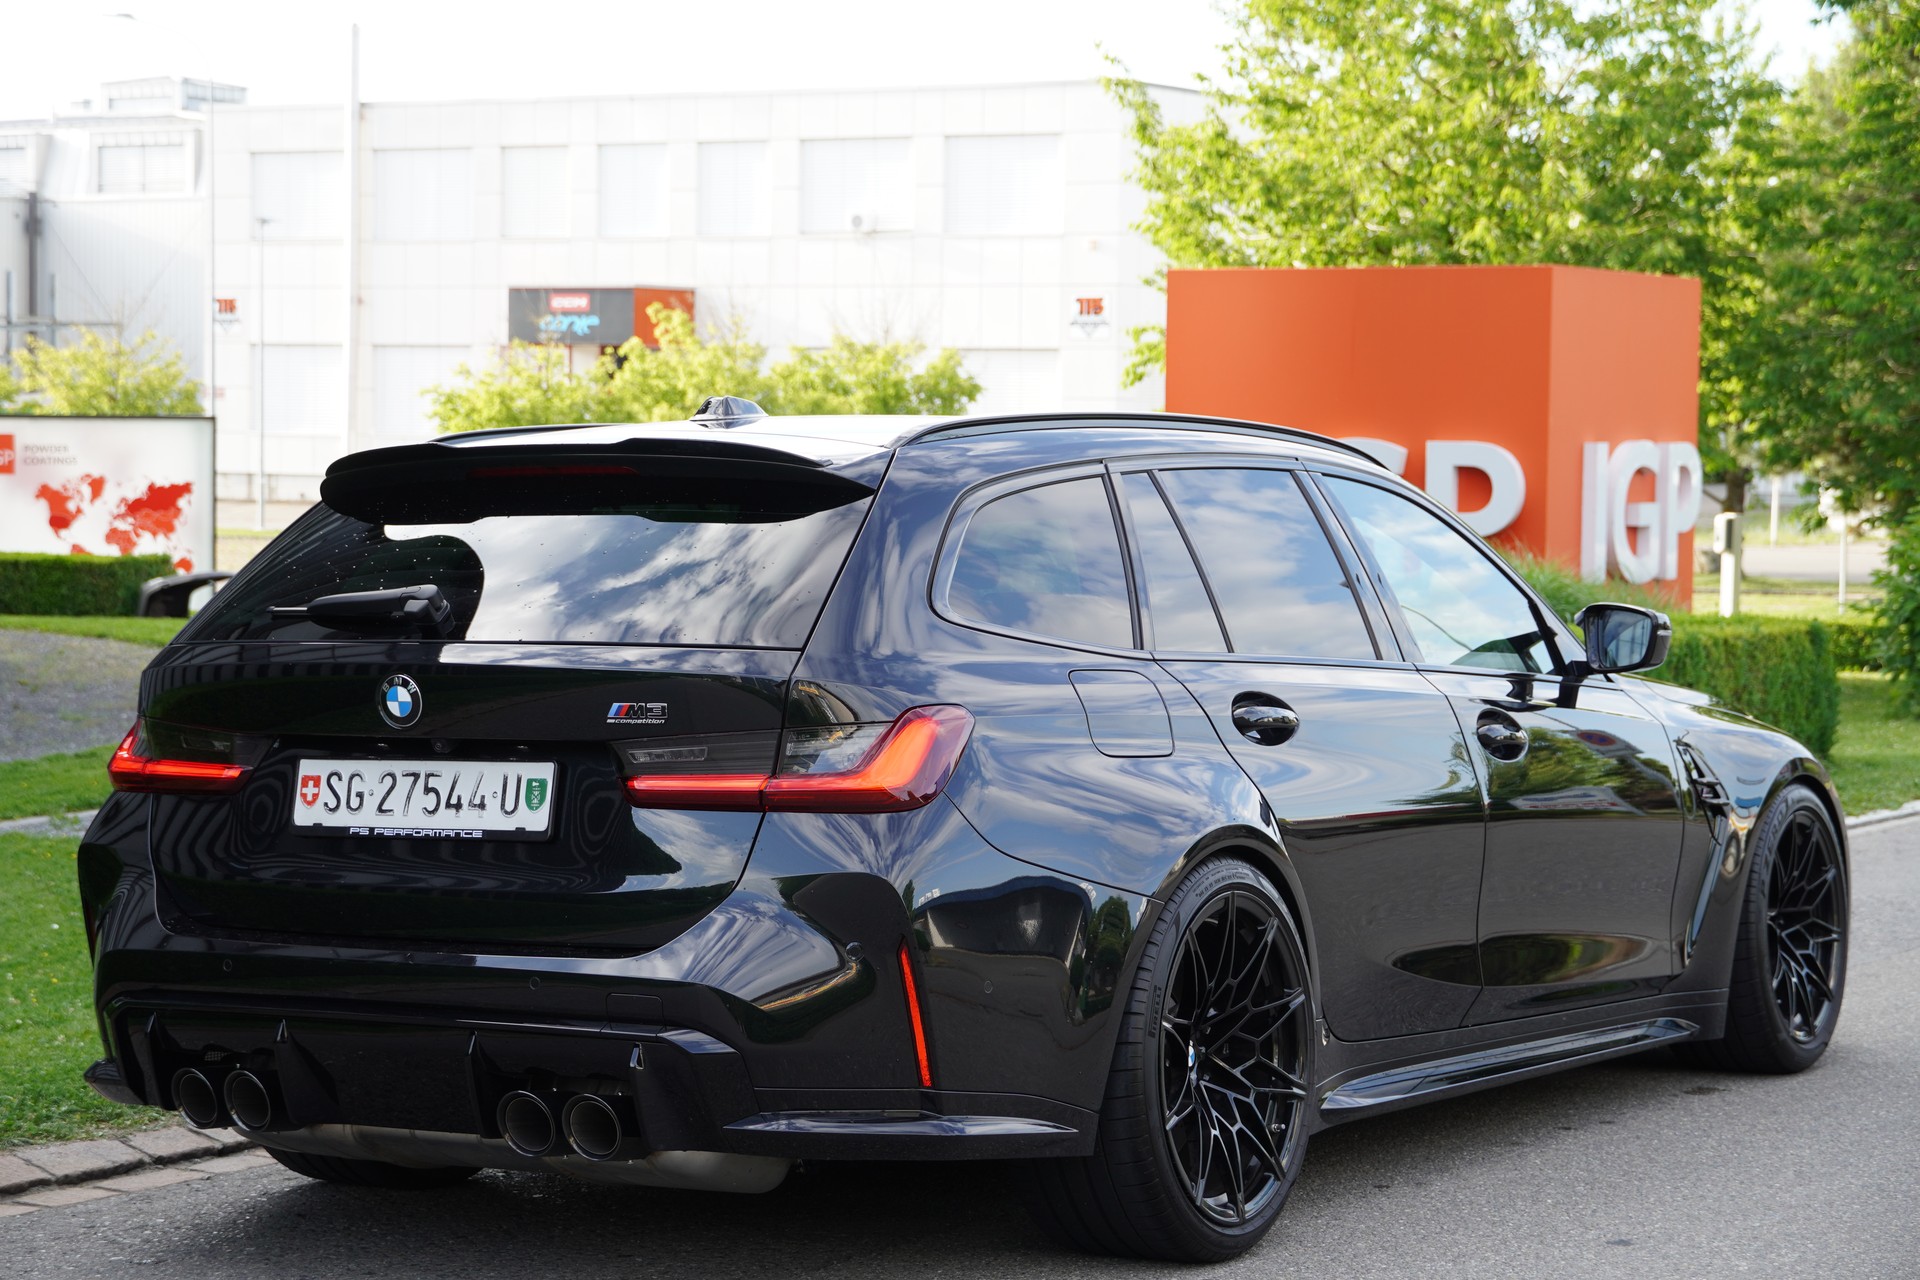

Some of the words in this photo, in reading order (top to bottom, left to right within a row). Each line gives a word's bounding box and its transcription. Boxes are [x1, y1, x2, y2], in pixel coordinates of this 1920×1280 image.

[1580, 439, 1703, 585] IGP
[382, 677, 417, 694] BMW
[607, 703, 668, 718] M3
[349, 827, 369, 835] PS
[374, 828, 483, 838] PERFORMANCE
